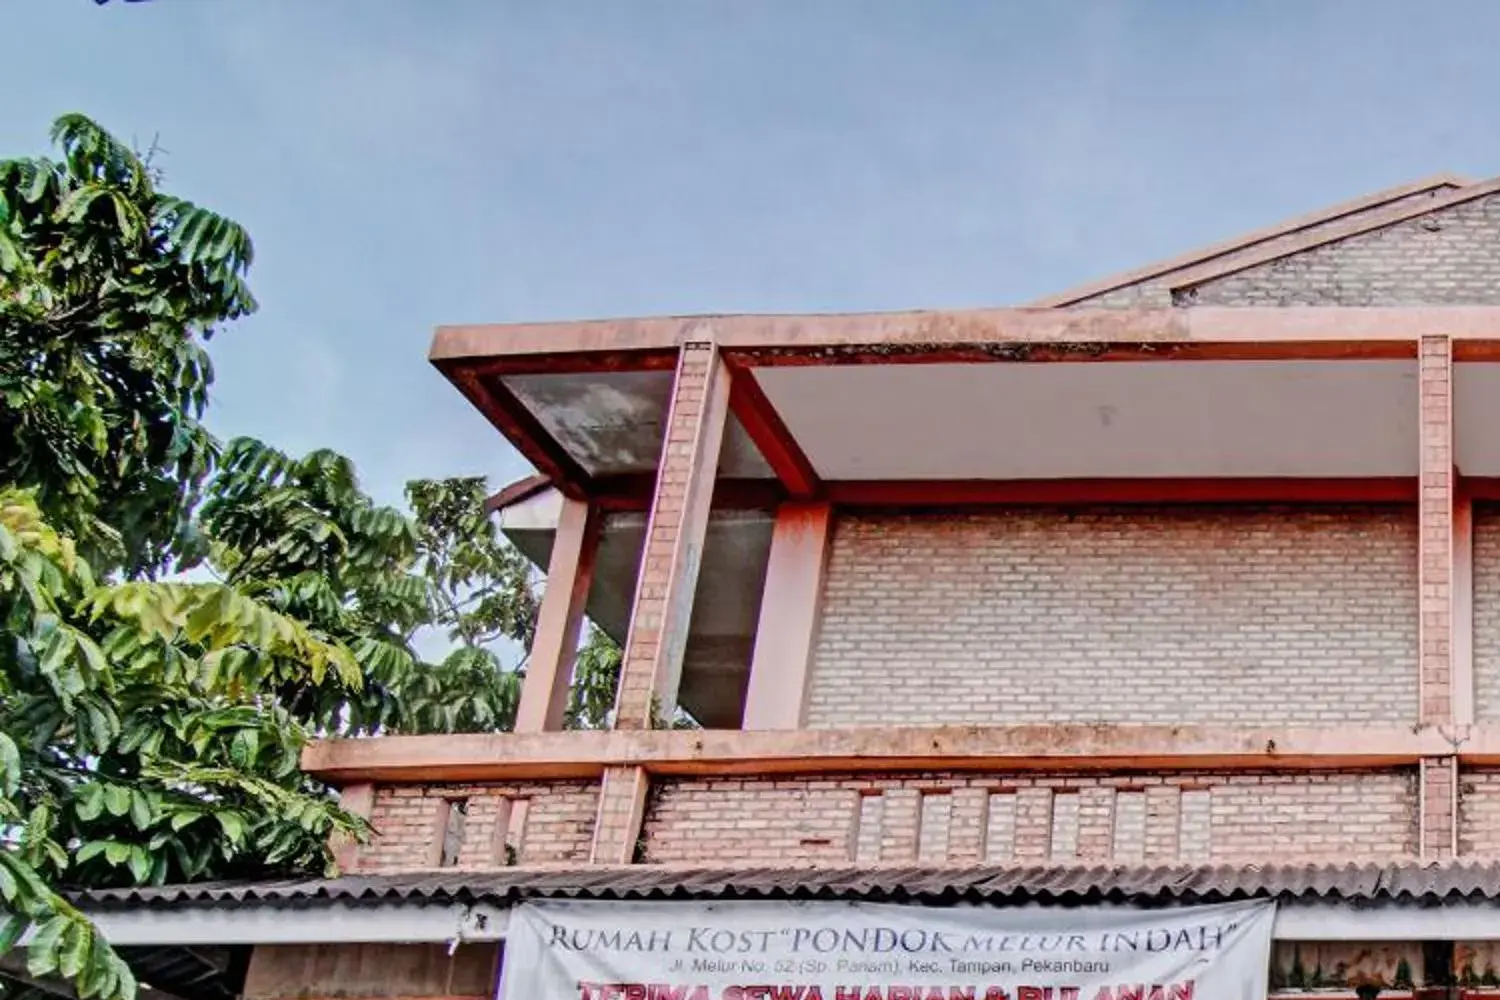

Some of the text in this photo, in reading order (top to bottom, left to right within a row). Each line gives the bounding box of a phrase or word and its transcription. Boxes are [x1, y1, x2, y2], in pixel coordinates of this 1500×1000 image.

[550, 925, 671, 951] RUMAH
[687, 927, 776, 953] KOST
[691, 959, 735, 973] Melur
[774, 960, 795, 973] 52
[909, 959, 943, 973] Kec.
[950, 959, 1016, 975] Tampan,
[1021, 958, 1110, 973] Pekanbaru
